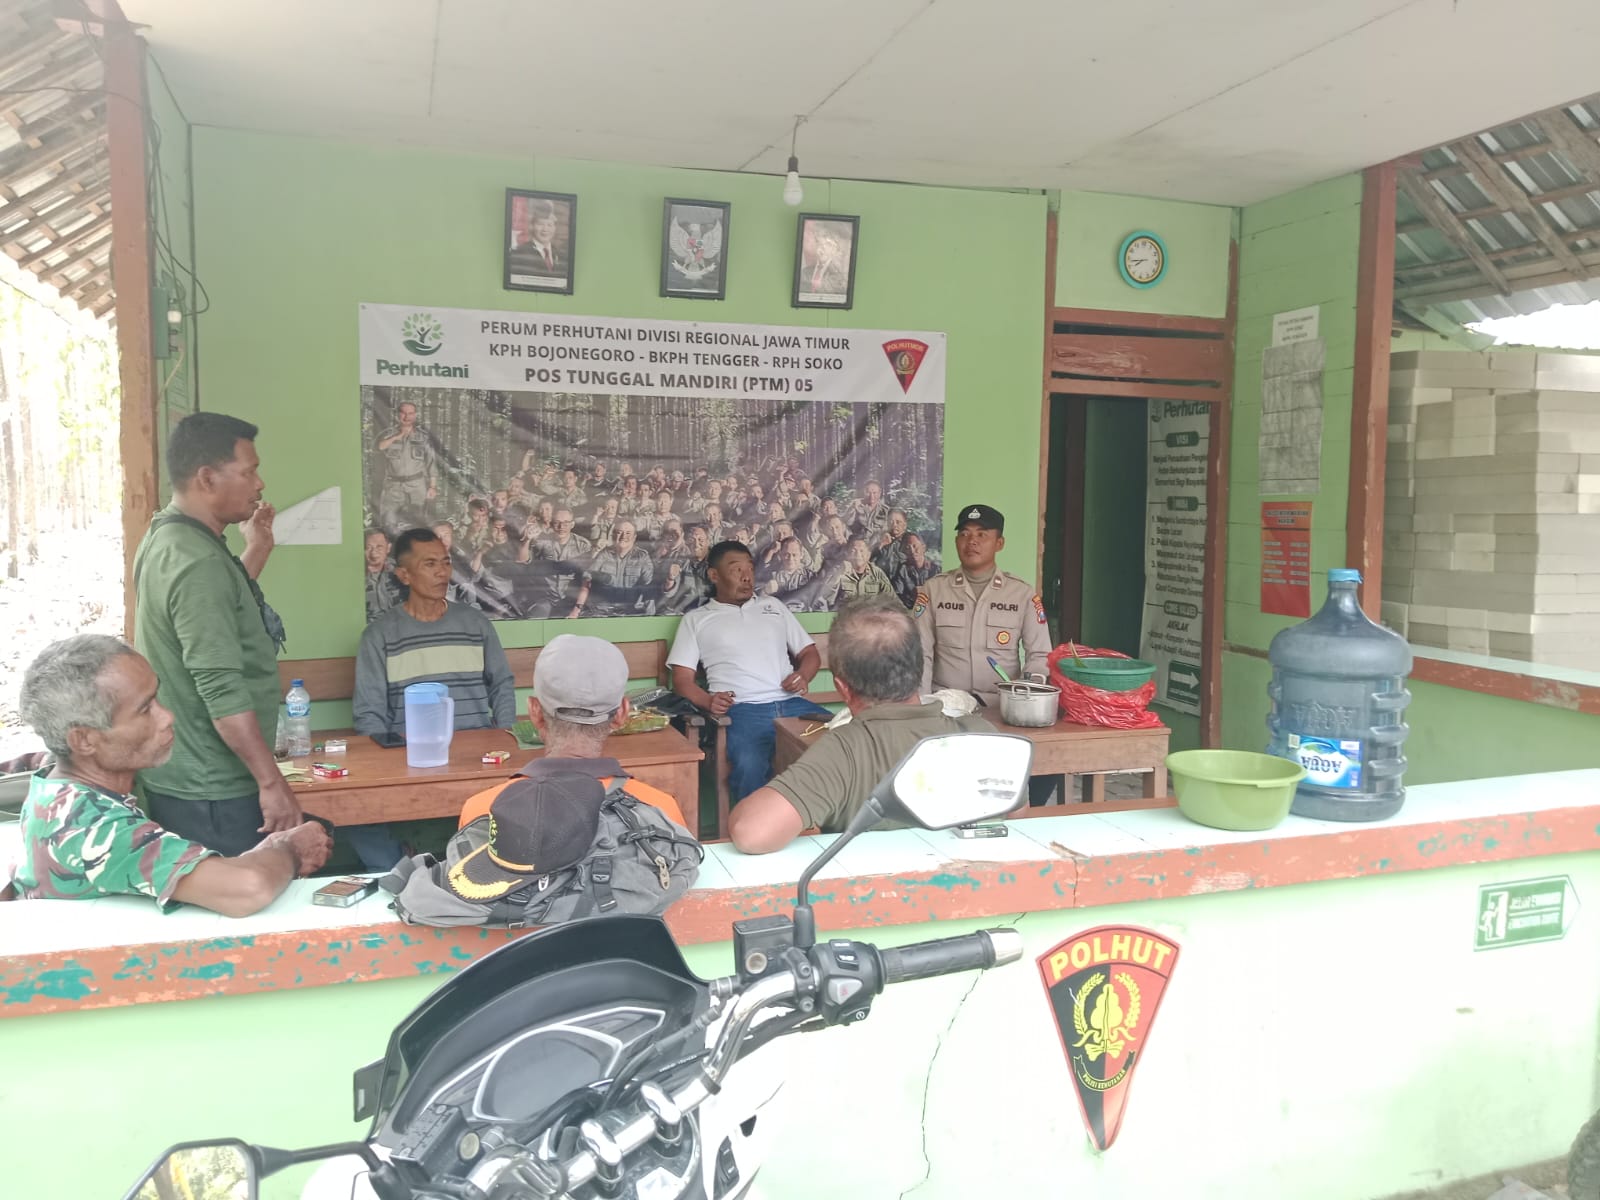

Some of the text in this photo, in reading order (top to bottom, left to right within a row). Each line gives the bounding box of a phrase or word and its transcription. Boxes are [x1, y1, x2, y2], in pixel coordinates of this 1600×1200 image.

[480, 320, 850, 350] PERUM PERHUTANI DIVISI REGIONAL JAWA TIMUR
[489, 343, 522, 357] KPH
[528, 345, 635, 362] BOJONEGORO
[649, 350, 688, 364] BKPH
[693, 353, 759, 368] TENGGER
[772, 356, 800, 369] RPH
[805, 357, 843, 370] SOKO
[376, 358, 469, 379] Perhutani
[525, 367, 813, 393] POS TUNGGAL MANDIRI (PTM) 05
[937, 602, 965, 611] AGUS
[990, 602, 1018, 611] POLRI
[1300, 755, 1343, 773] AQUA
[1049, 934, 1172, 980] POLHUT
